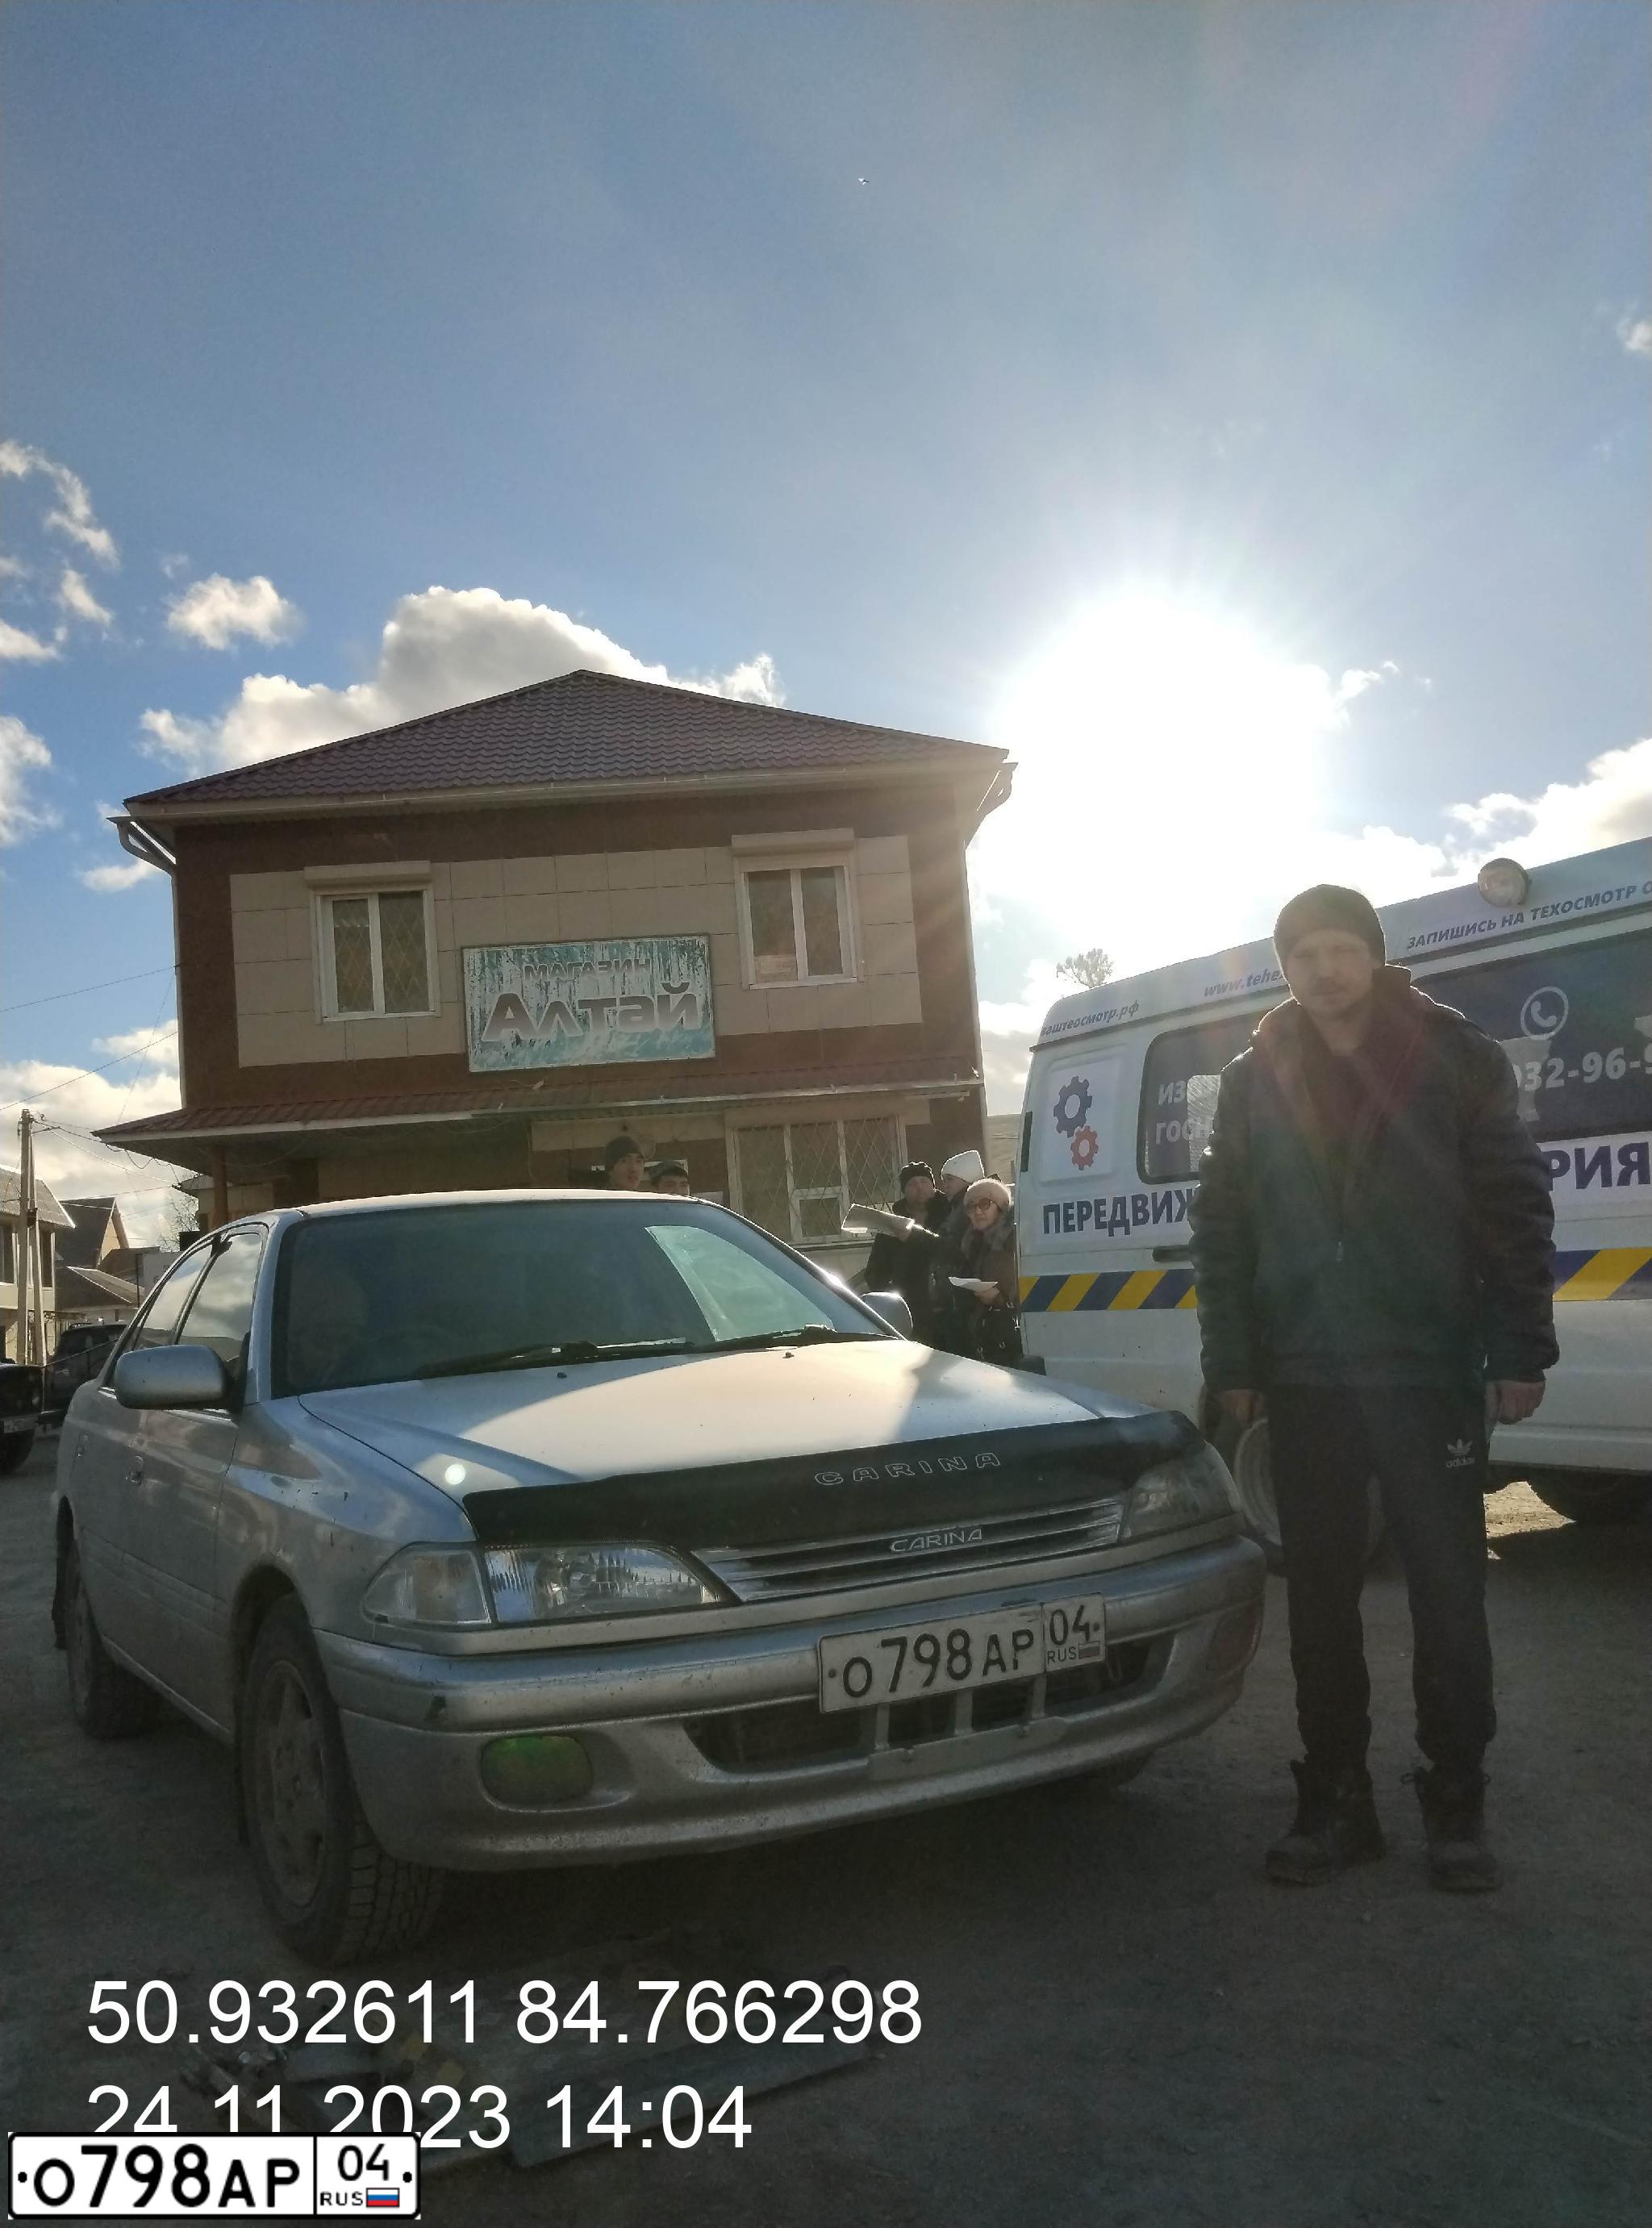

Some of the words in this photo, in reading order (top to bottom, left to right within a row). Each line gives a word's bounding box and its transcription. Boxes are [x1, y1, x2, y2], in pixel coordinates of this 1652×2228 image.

[1407, 917, 1497, 949] ЗАПИШИСЬ
[1501, 912, 1525, 927] НА
[1531, 885, 1637, 920] ТЕХОСМОТР
[524, 958, 653, 982] МАГАЗИН
[815, 1452, 1001, 1485] CARINA
[890, 1529, 982, 1553] CARINA
[1049, 1604, 1092, 1646] 04
[1048, 1646, 1077, 1665] RUS
